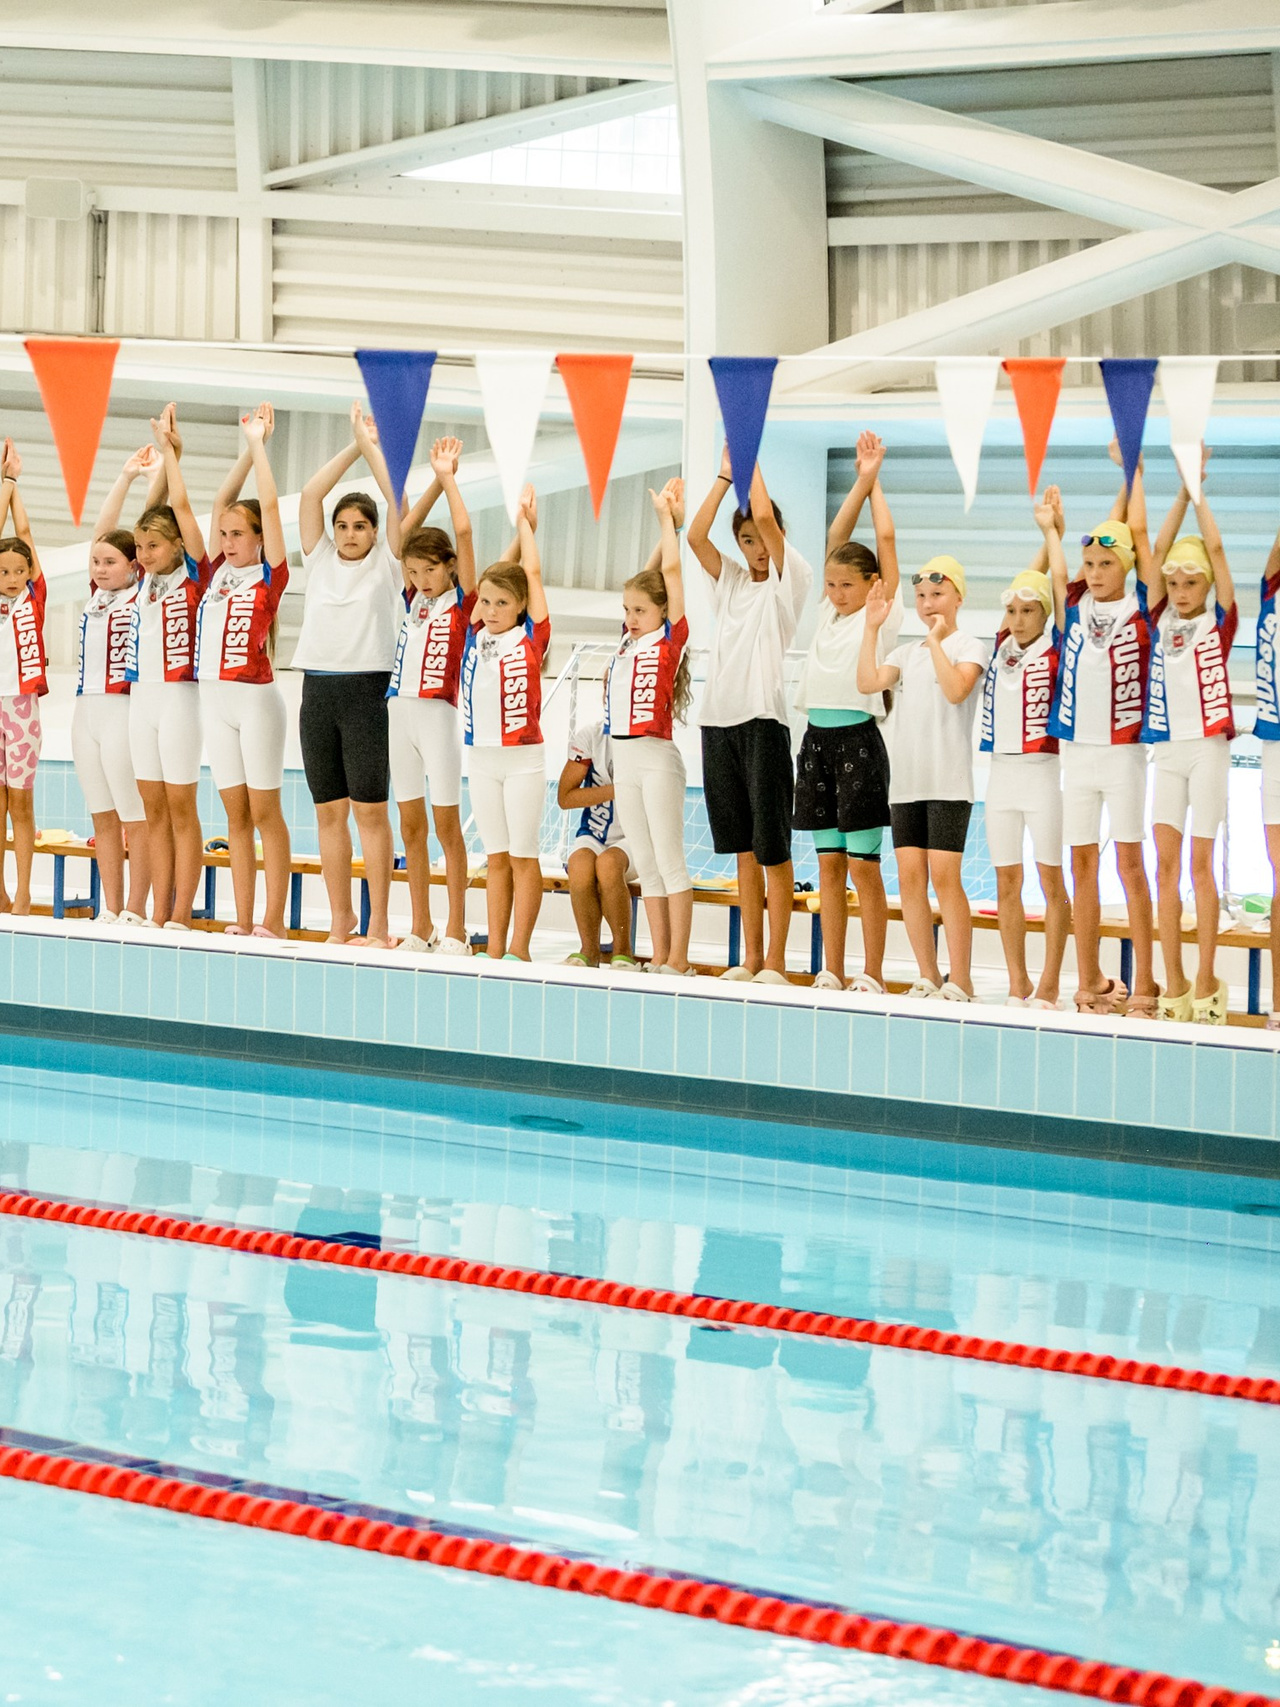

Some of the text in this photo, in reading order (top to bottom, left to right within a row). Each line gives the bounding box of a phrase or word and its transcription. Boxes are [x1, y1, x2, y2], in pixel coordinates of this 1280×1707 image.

[15, 601, 42, 683] RUSSIA
[165, 588, 190, 671] RUSSIA
[223, 588, 257, 670] RUSSIA
[422, 613, 452, 690] RUSSIA
[503, 644, 528, 734] RUSSIA
[633, 645, 660, 725] RUSSIA
[1024, 656, 1051, 742] RUSSIA
[1058, 622, 1084, 727] RUSSIA
[1112, 622, 1142, 731] RUSSIA
[1196, 631, 1230, 727] RUSSIA
